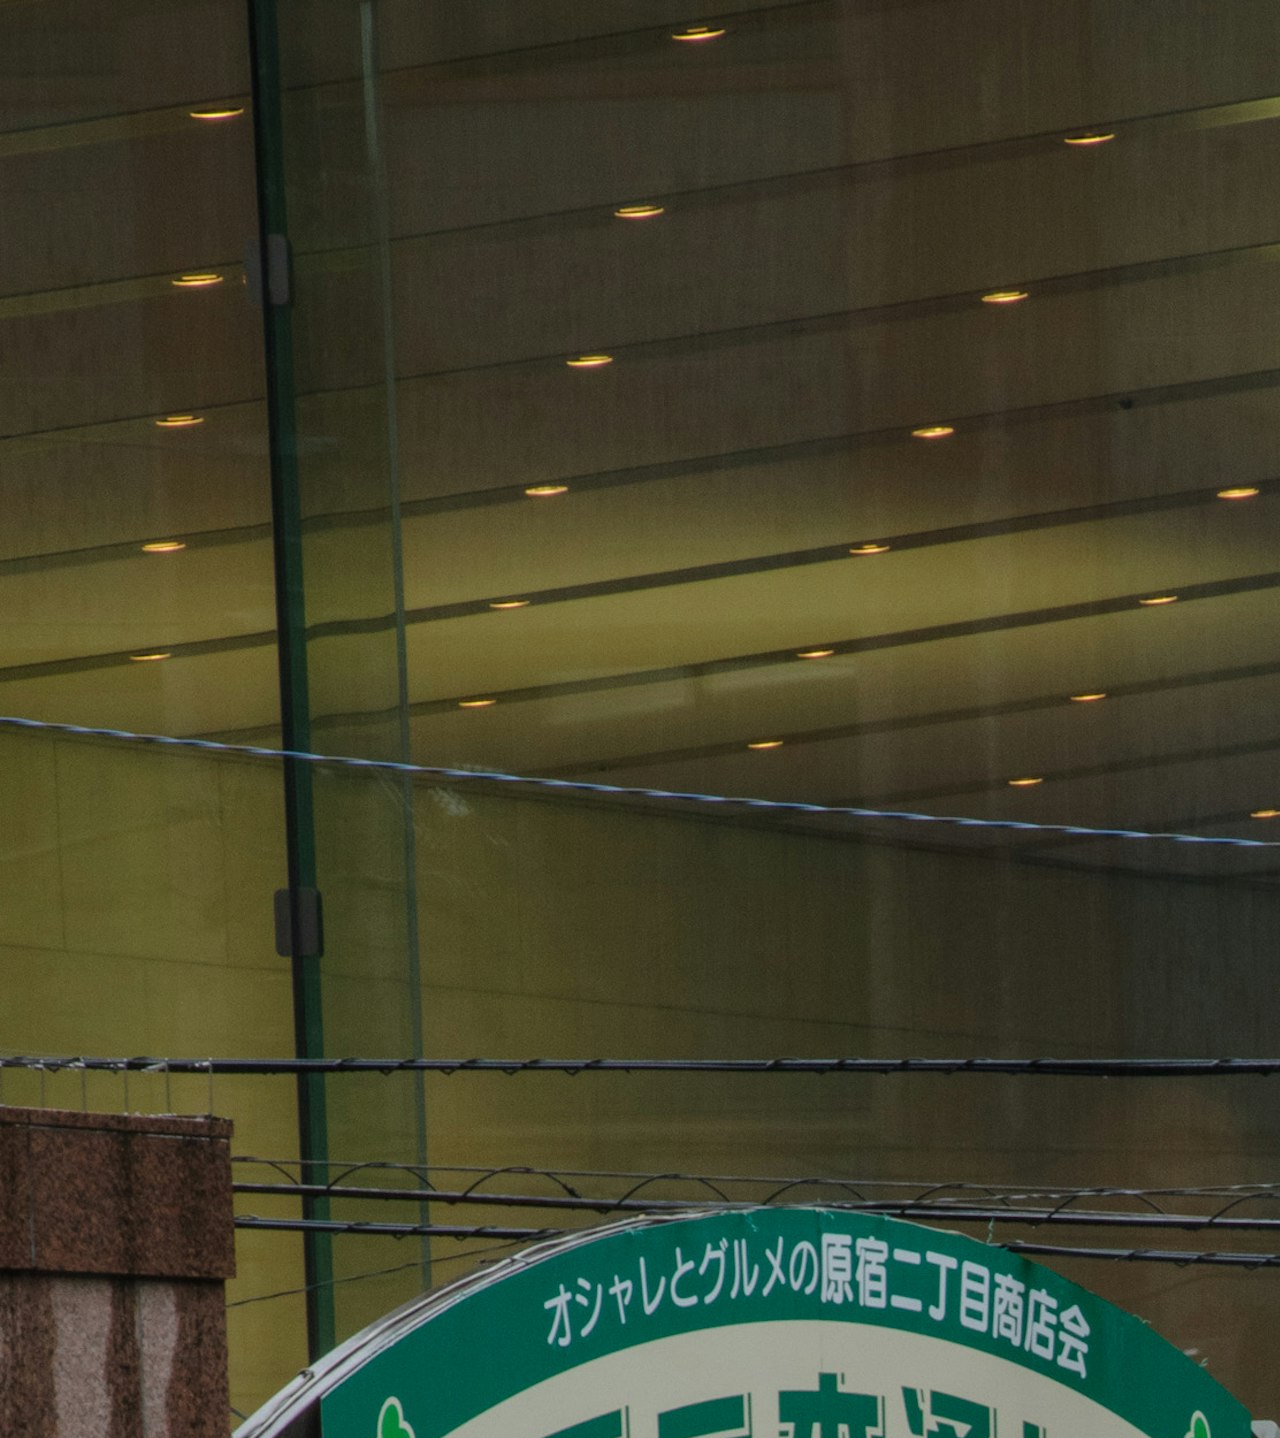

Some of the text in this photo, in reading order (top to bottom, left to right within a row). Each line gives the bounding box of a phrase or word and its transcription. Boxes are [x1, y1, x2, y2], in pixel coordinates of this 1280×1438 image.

[543, 1231, 1092, 1380] オシャレとグルメの原宿二丁目商店会
